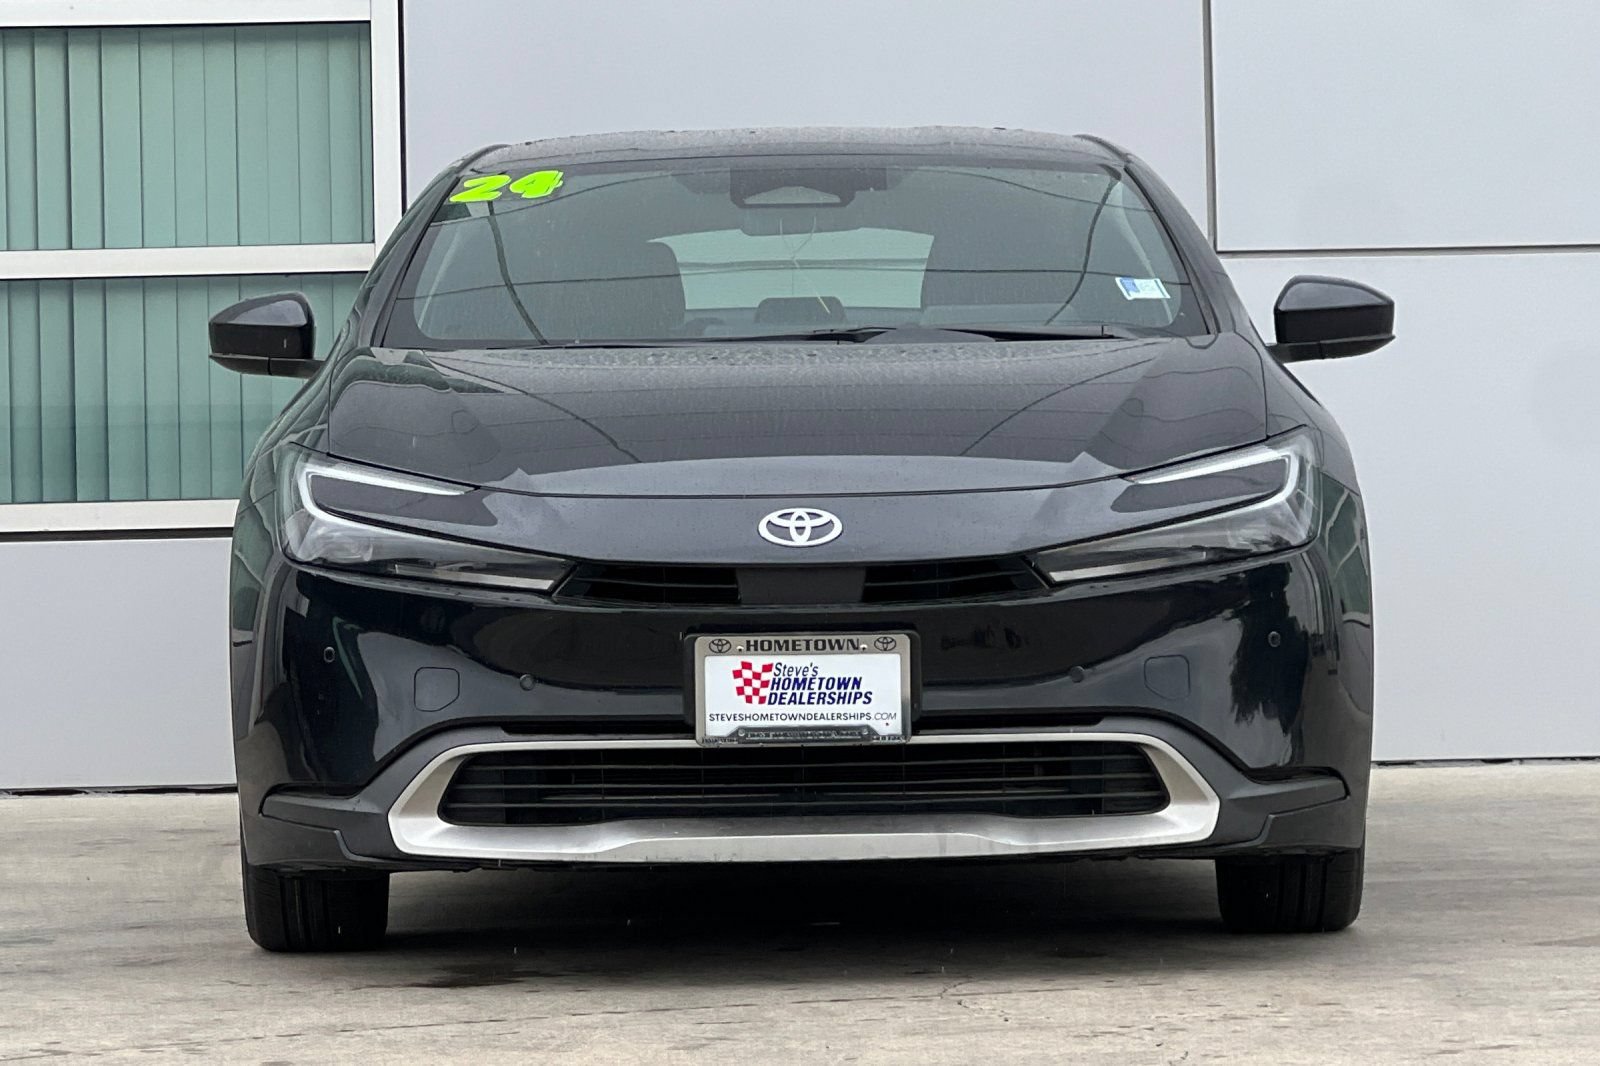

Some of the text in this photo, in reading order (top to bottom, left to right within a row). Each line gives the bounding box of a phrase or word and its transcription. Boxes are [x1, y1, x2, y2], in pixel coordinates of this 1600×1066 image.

[449, 170, 564, 203] 24
[746, 638, 860, 652] HOMETOWN
[773, 662, 818, 677] Steve's
[770, 677, 862, 690] HOMETOWN
[767, 691, 872, 705] DEALERSHIPS
[709, 712, 897, 721] STEVESHOMETOWNDEALERSHIPS.COM
